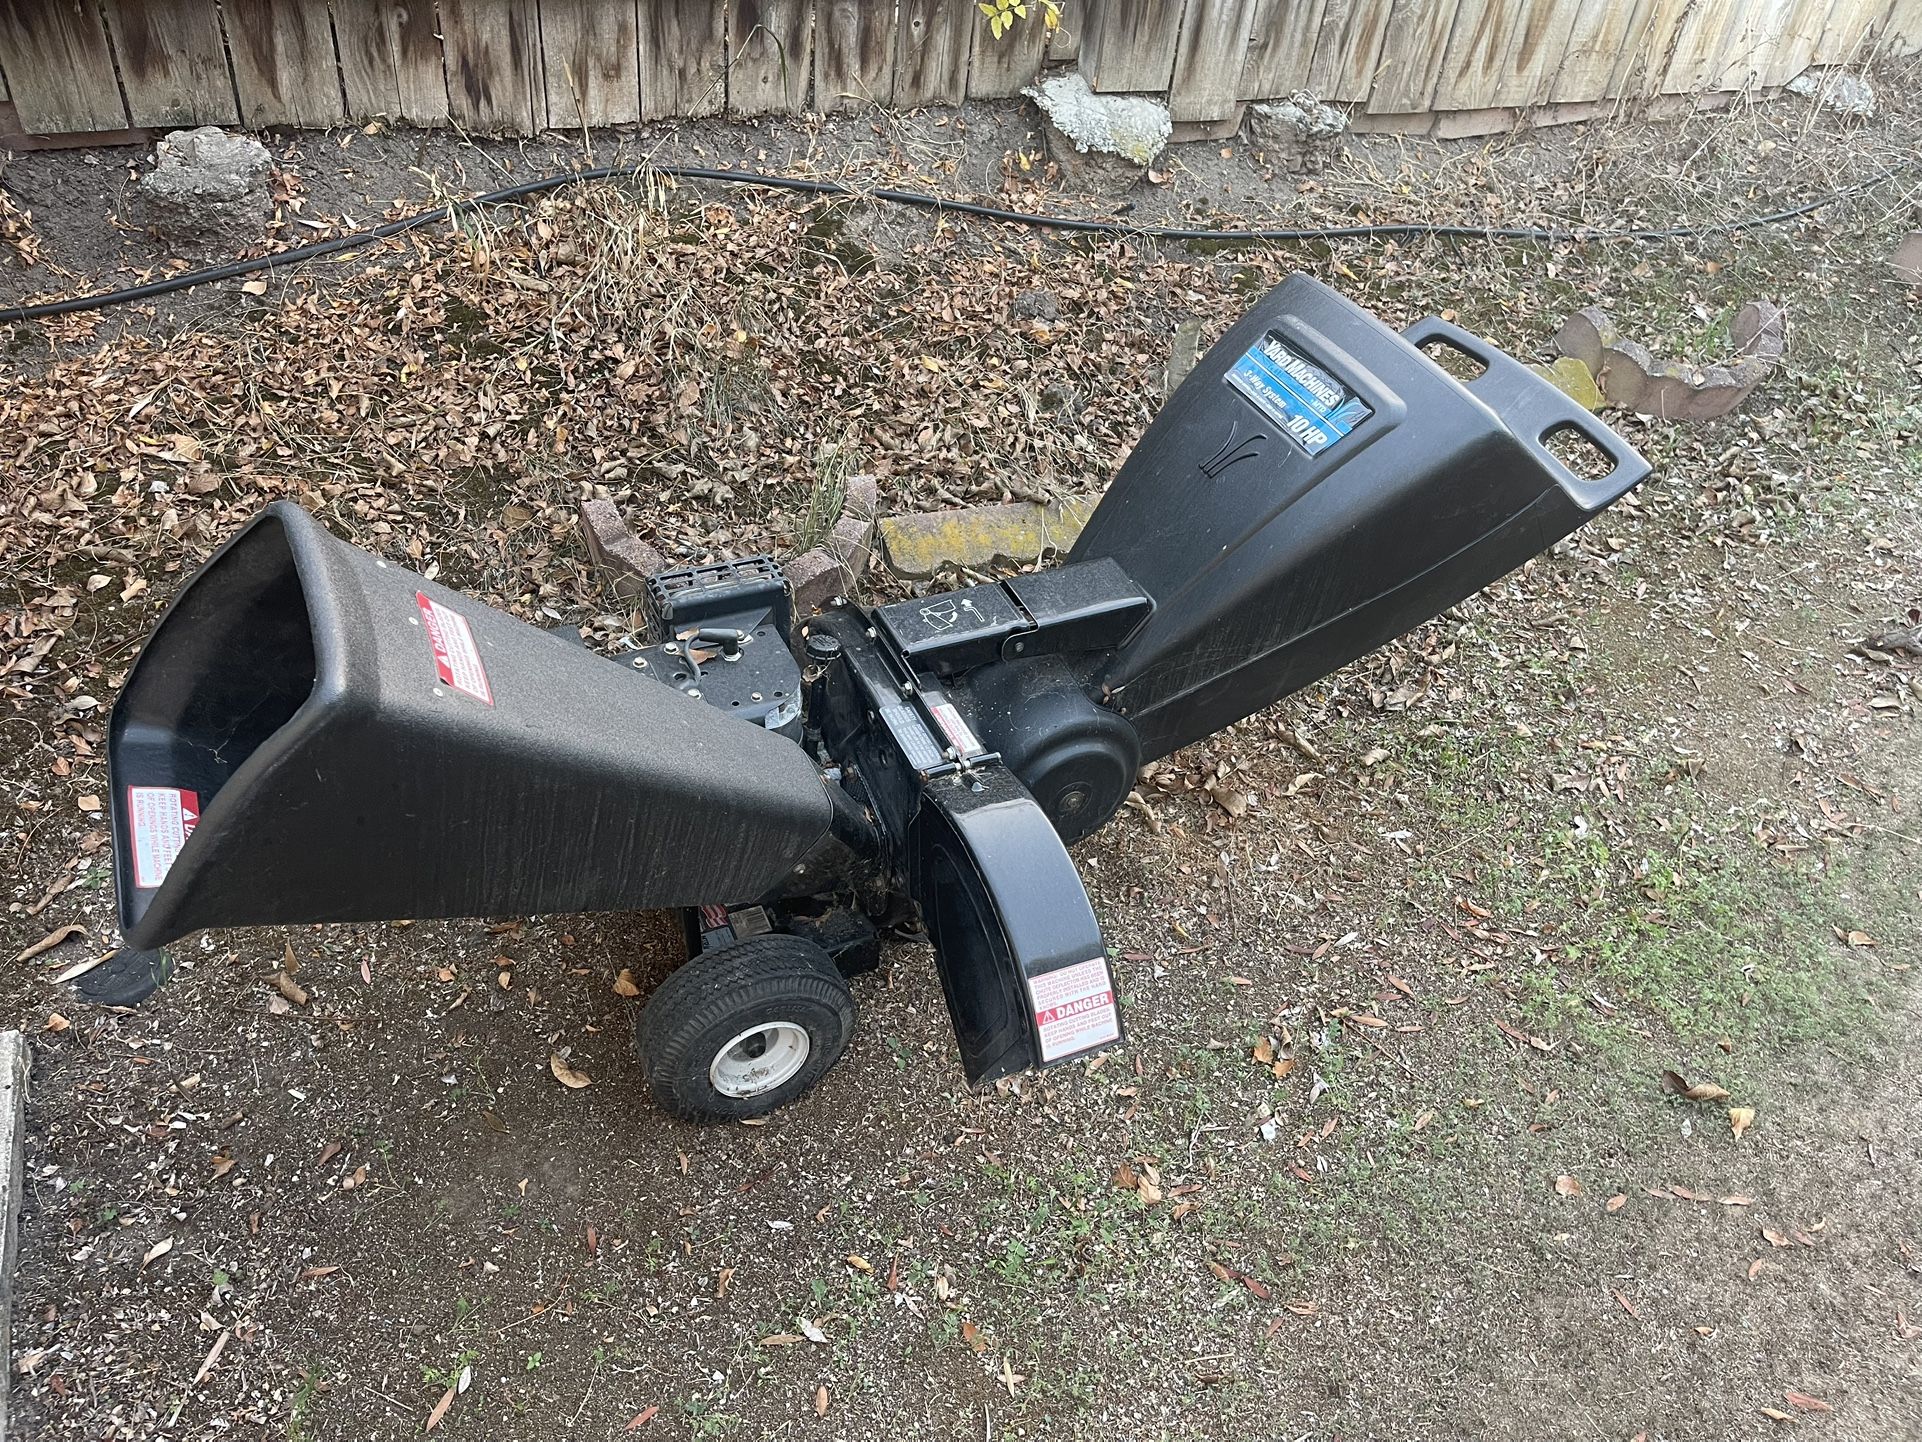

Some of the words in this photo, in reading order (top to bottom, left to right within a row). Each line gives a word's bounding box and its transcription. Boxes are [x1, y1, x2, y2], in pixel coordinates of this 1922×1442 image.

[1263, 339, 1294, 373] YARD
[1284, 360, 1340, 406] MACHINES
[1243, 370, 1265, 390] 3-Way
[1262, 386, 1288, 409] System
[1287, 414, 1310, 433] 10
[1300, 422, 1329, 445] HP
[422, 608, 446, 653] DANGER
[158, 793, 166, 809] KEEP
[159, 811, 168, 833] HANDS
[1055, 992, 1109, 1019] DANGER
